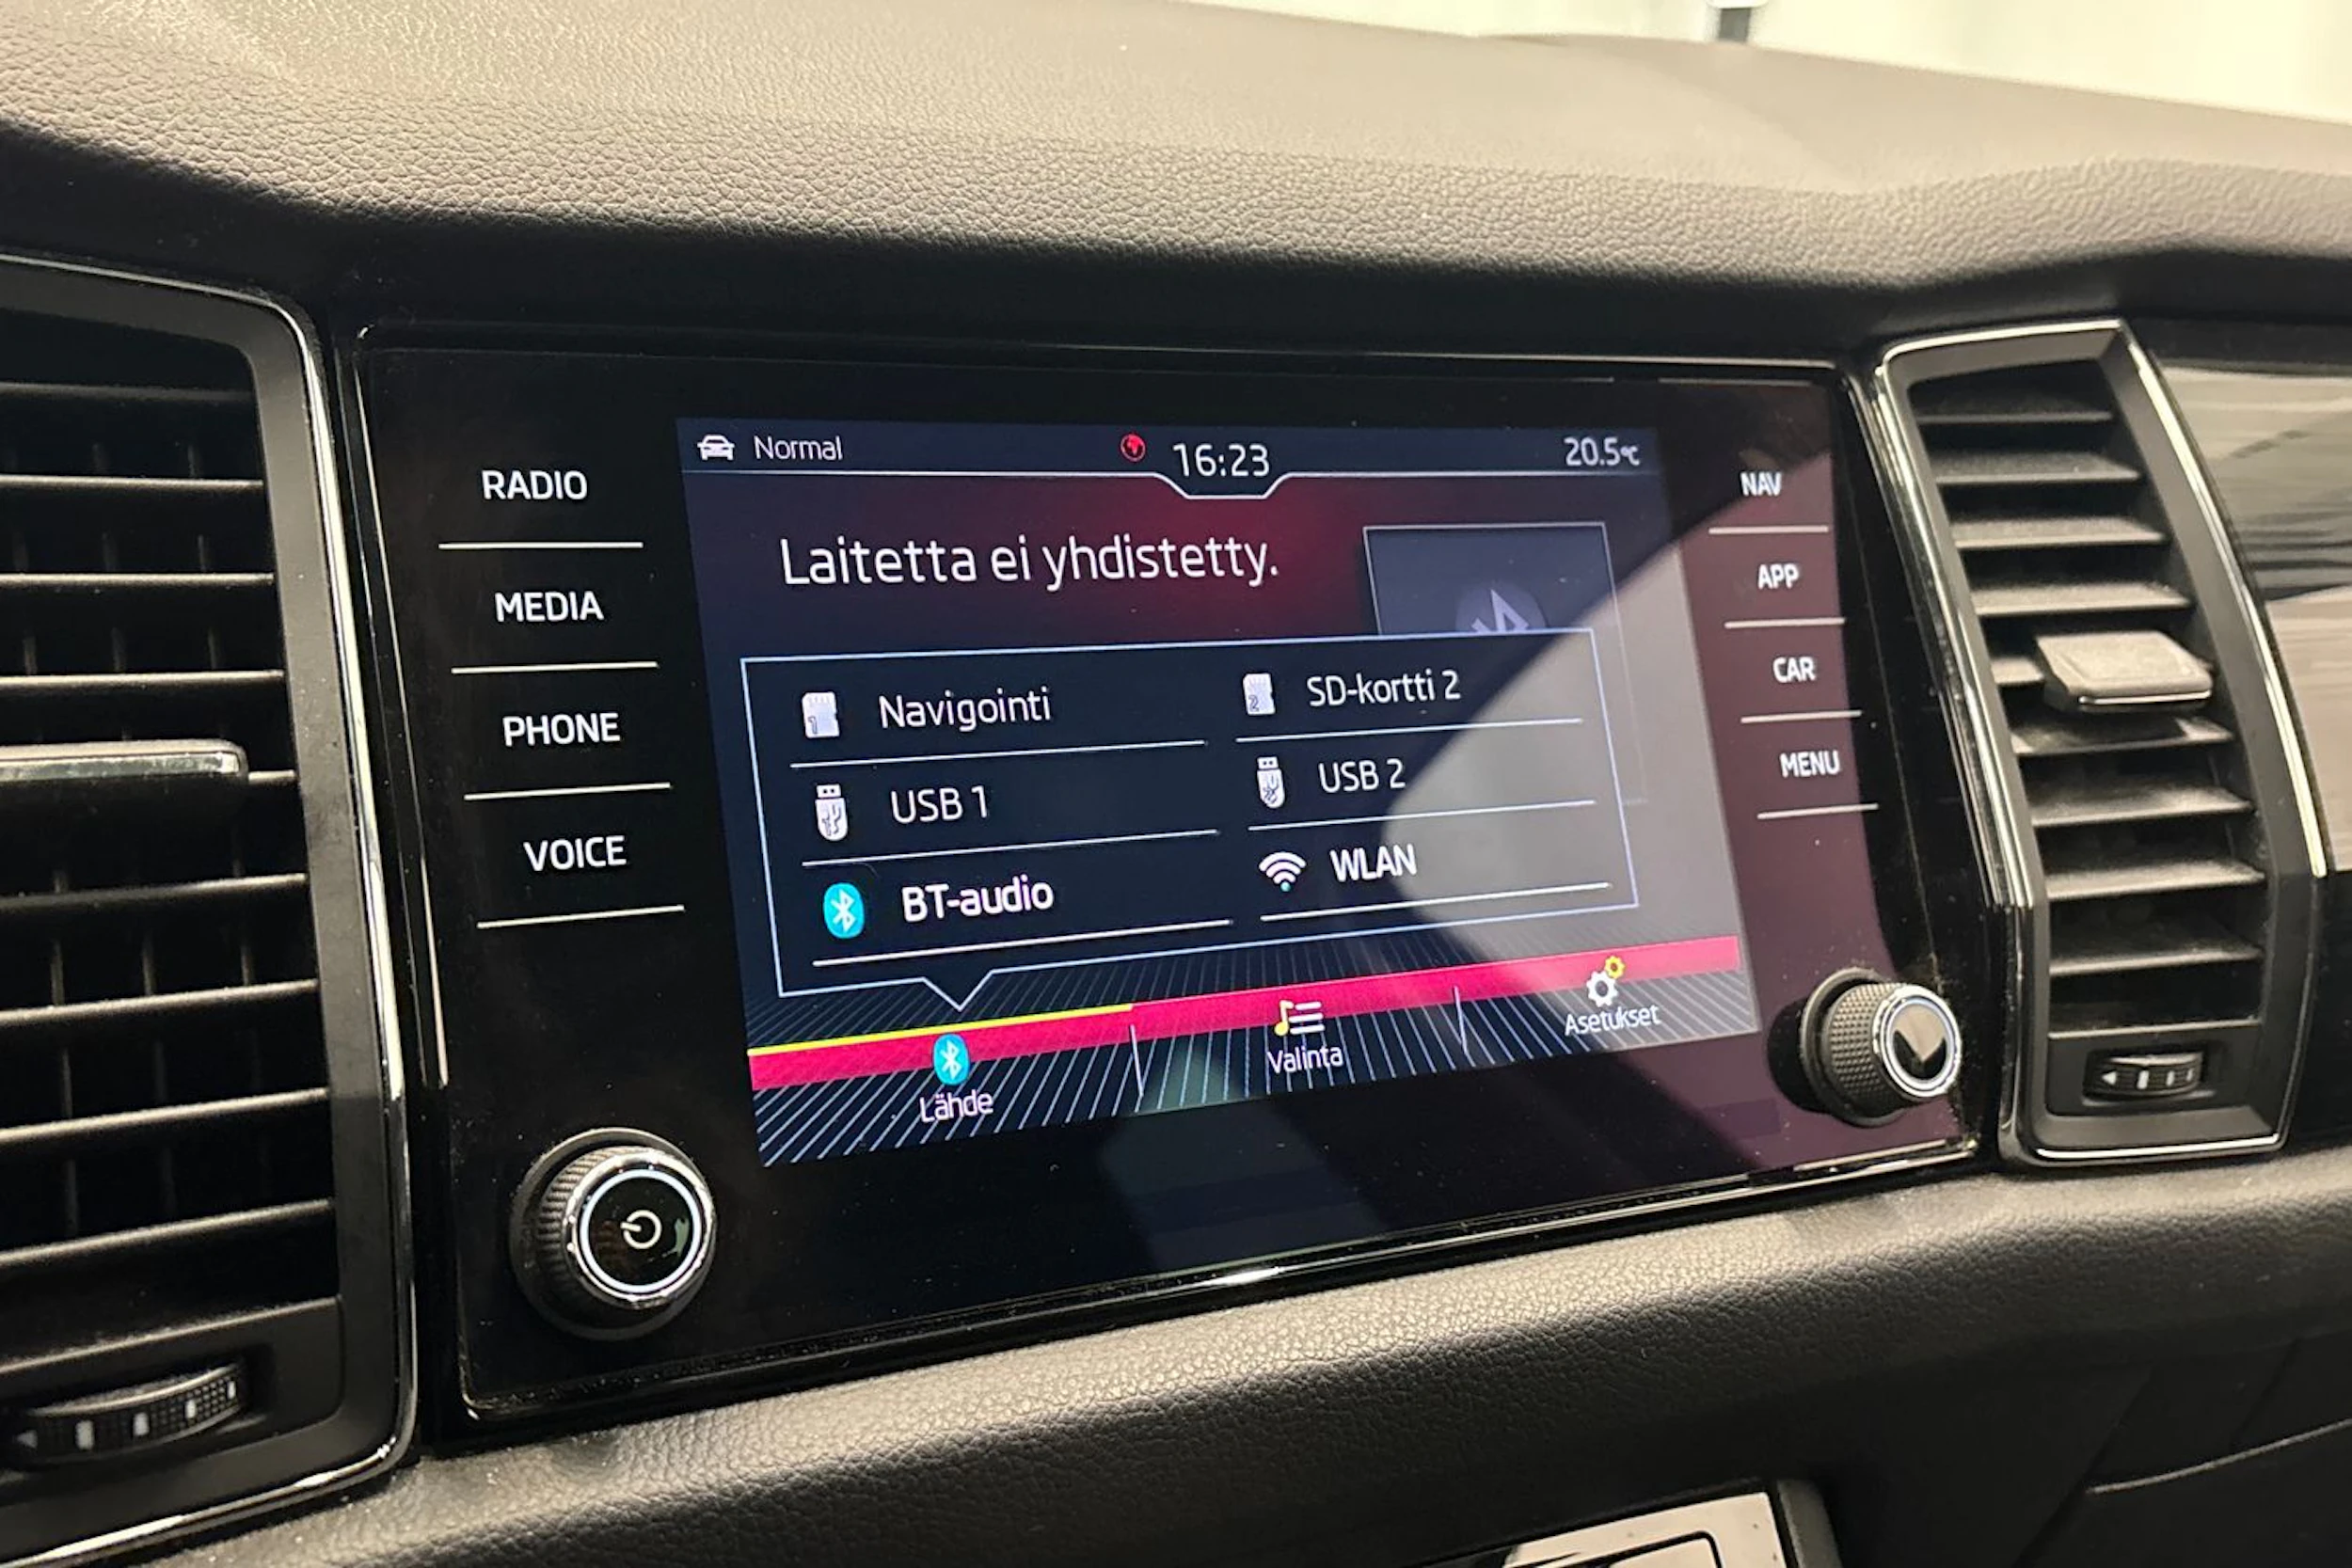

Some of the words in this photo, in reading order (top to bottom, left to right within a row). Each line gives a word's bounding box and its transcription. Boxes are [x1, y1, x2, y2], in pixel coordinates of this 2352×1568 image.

[755, 436, 843, 461] Normal
[1173, 443, 1269, 476] 16:23
[482, 470, 588, 500] RADIO
[1740, 472, 1782, 496] NAV
[781, 534, 977, 585] Laitetta
[992, 534, 1031, 581] ei
[1041, 533, 1278, 592] yhdistetty.
[1757, 563, 1799, 589] APP
[495, 591, 604, 622] MEDIA
[1773, 657, 1816, 682] CAR
[1307, 669, 1437, 706] SD-kortti
[1441, 670, 1461, 700] 2
[879, 687, 1051, 732] Navigointi
[502, 713, 621, 746] PHONE
[1319, 760, 1379, 794] USB
[1387, 758, 1406, 789] 2
[1780, 751, 1840, 777] MENU
[891, 787, 963, 824] USB
[972, 785, 989, 818] 1
[523, 835, 628, 871] VOICE
[1330, 845, 1417, 882] WLAN
[901, 875, 1055, 922] BT-audio
[1565, 1005, 1661, 1036] Asetukset
[1266, 1045, 1343, 1075] Valinta
[919, 1089, 994, 1123] Lähde
